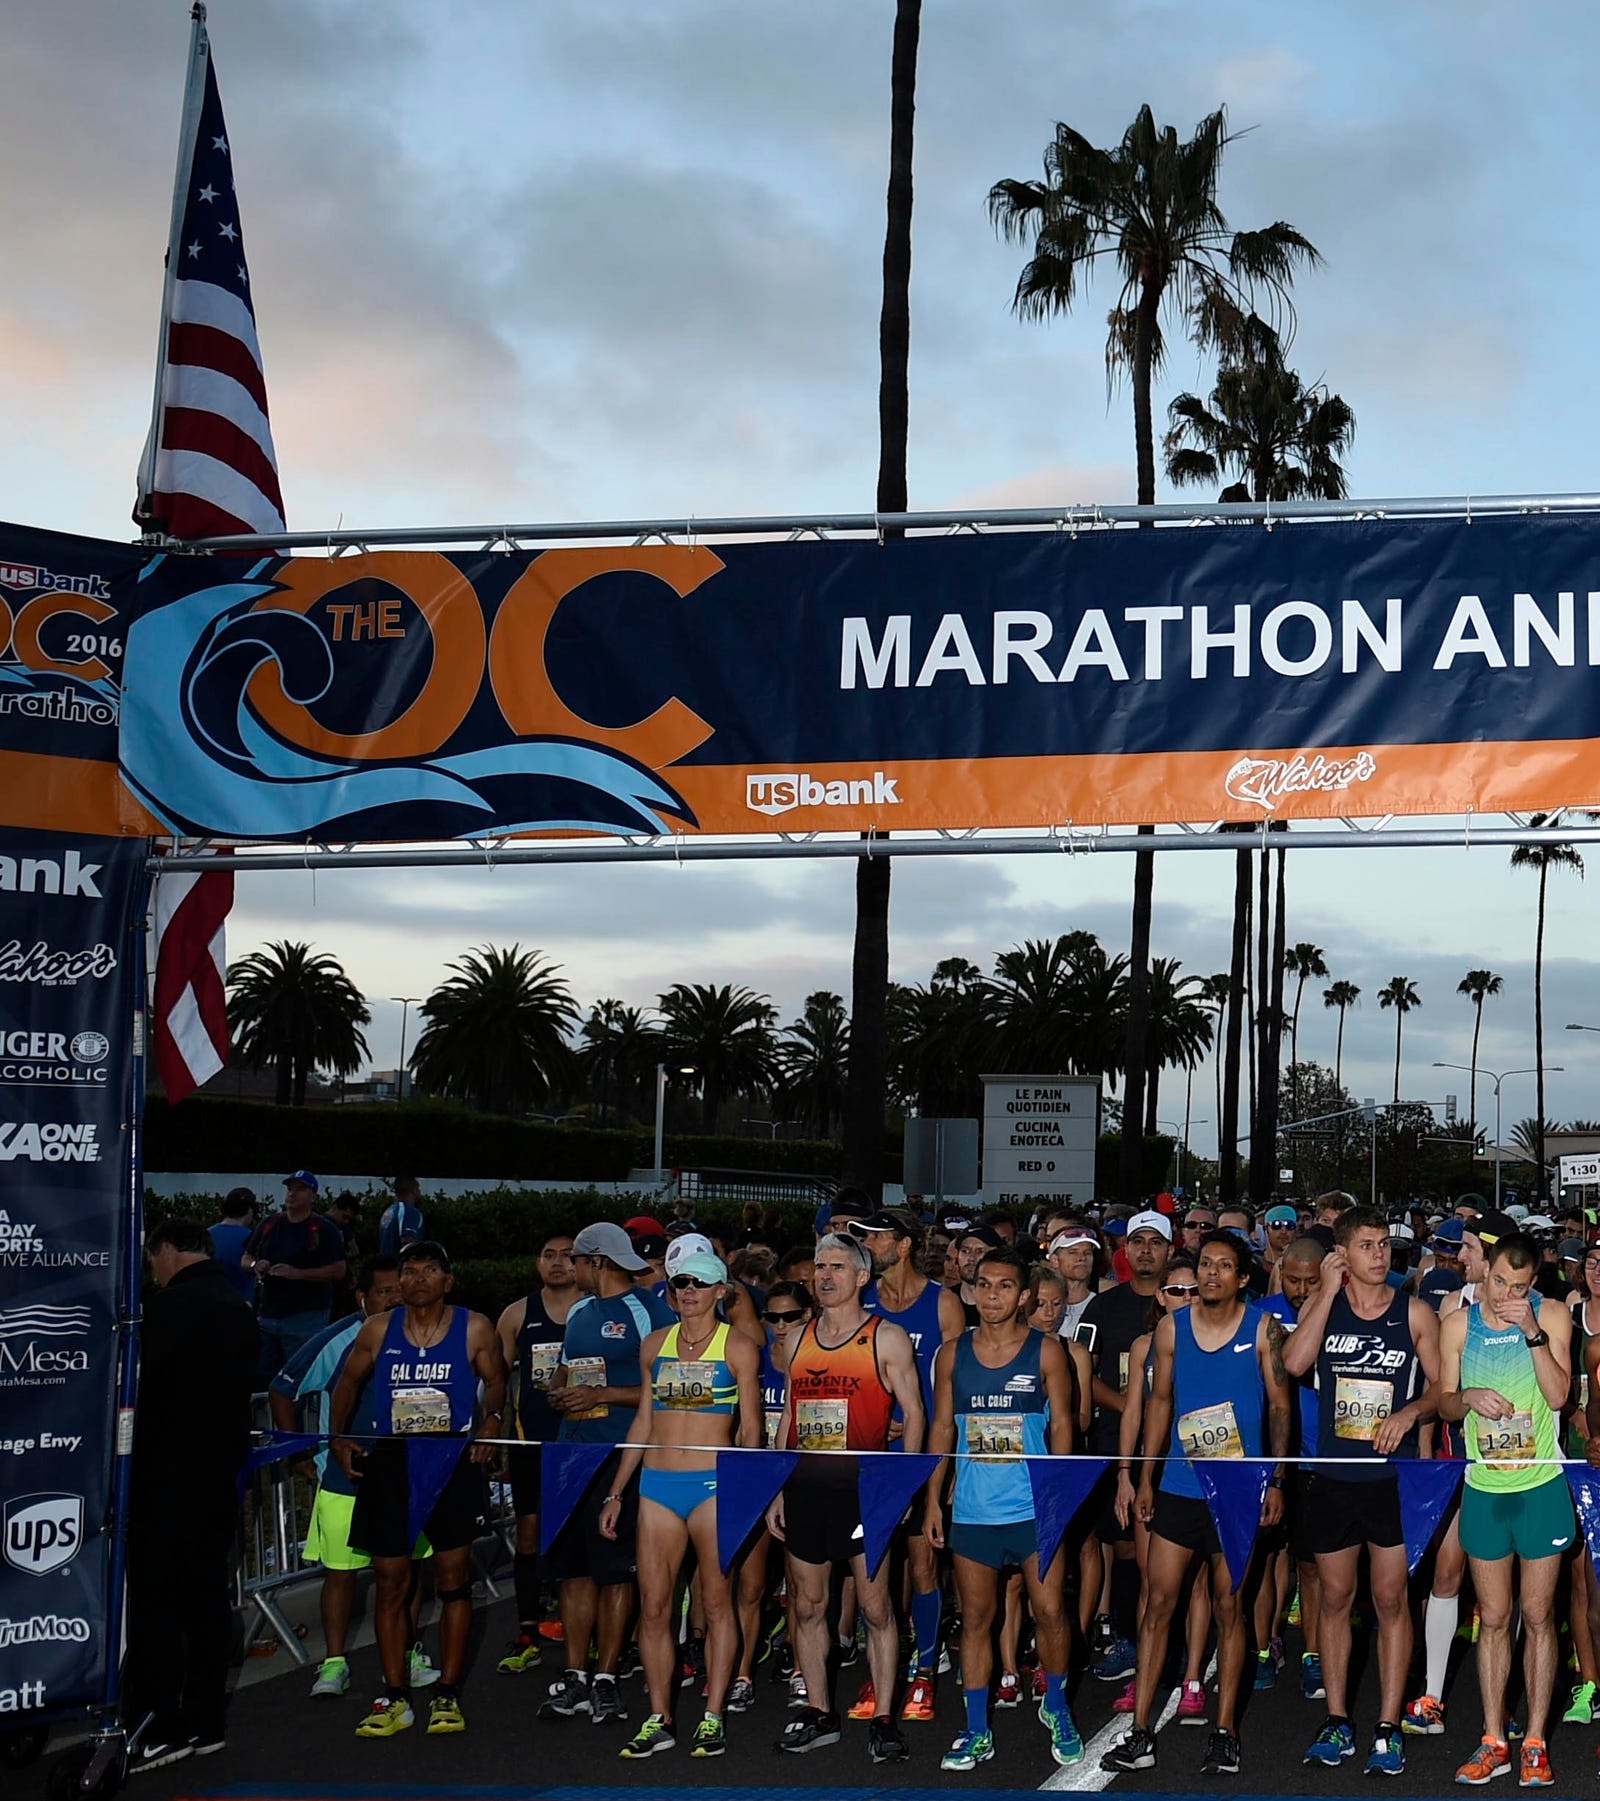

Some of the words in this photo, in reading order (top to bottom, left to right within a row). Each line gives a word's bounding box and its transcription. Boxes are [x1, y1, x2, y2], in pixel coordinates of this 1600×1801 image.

[327, 600, 406, 643] THE
[66, 634, 123, 658] 2016
[840, 598, 1402, 689] MARATHON
[247, 545, 726, 772] OC
[1265, 752, 1376, 795] Wahoo's
[0, 1065, 108, 1081] COHOLIC
[1016, 1089, 1029, 1100] LE
[1034, 1089, 1062, 1100] PAIN
[1007, 1102, 1070, 1113] QUOTIDIEN
[41, 1123, 97, 1142] ONE
[1015, 1122, 1060, 1132] CUCINA
[1010, 1136, 1064, 1146] ENOTECA
[43, 1143, 100, 1162] ONE
[1018, 1161, 1042, 1172] RED
[1047, 1161, 1056, 1172] O
[1570, 1164, 1597, 1176] 1:30
[1000, 1193, 1018, 1204] FIG
[32, 1252, 109, 1267] ALLIANCE
[1484, 1334, 1520, 1346] saucony
[391, 1364, 412, 1385] CAL
[415, 1363, 451, 1385] COAST
[533, 1367, 555, 1382] 97
[1331, 1365, 1362, 1374] Manhattan
[665, 1382, 703, 1398] 110
[791, 1374, 861, 1390] PHOENIX
[971, 1396, 985, 1408] CAL
[988, 1394, 1013, 1408] COAST
[1337, 1400, 1389, 1419] 9056
[394, 1416, 448, 1431] 12976
[798, 1422, 845, 1436] 11959
[40, 1433, 82, 1452] Envy
[979, 1437, 1013, 1451] 111
[1190, 1426, 1229, 1449] 109
[1485, 1432, 1525, 1451] 121
[10, 1517, 76, 1561] ups
